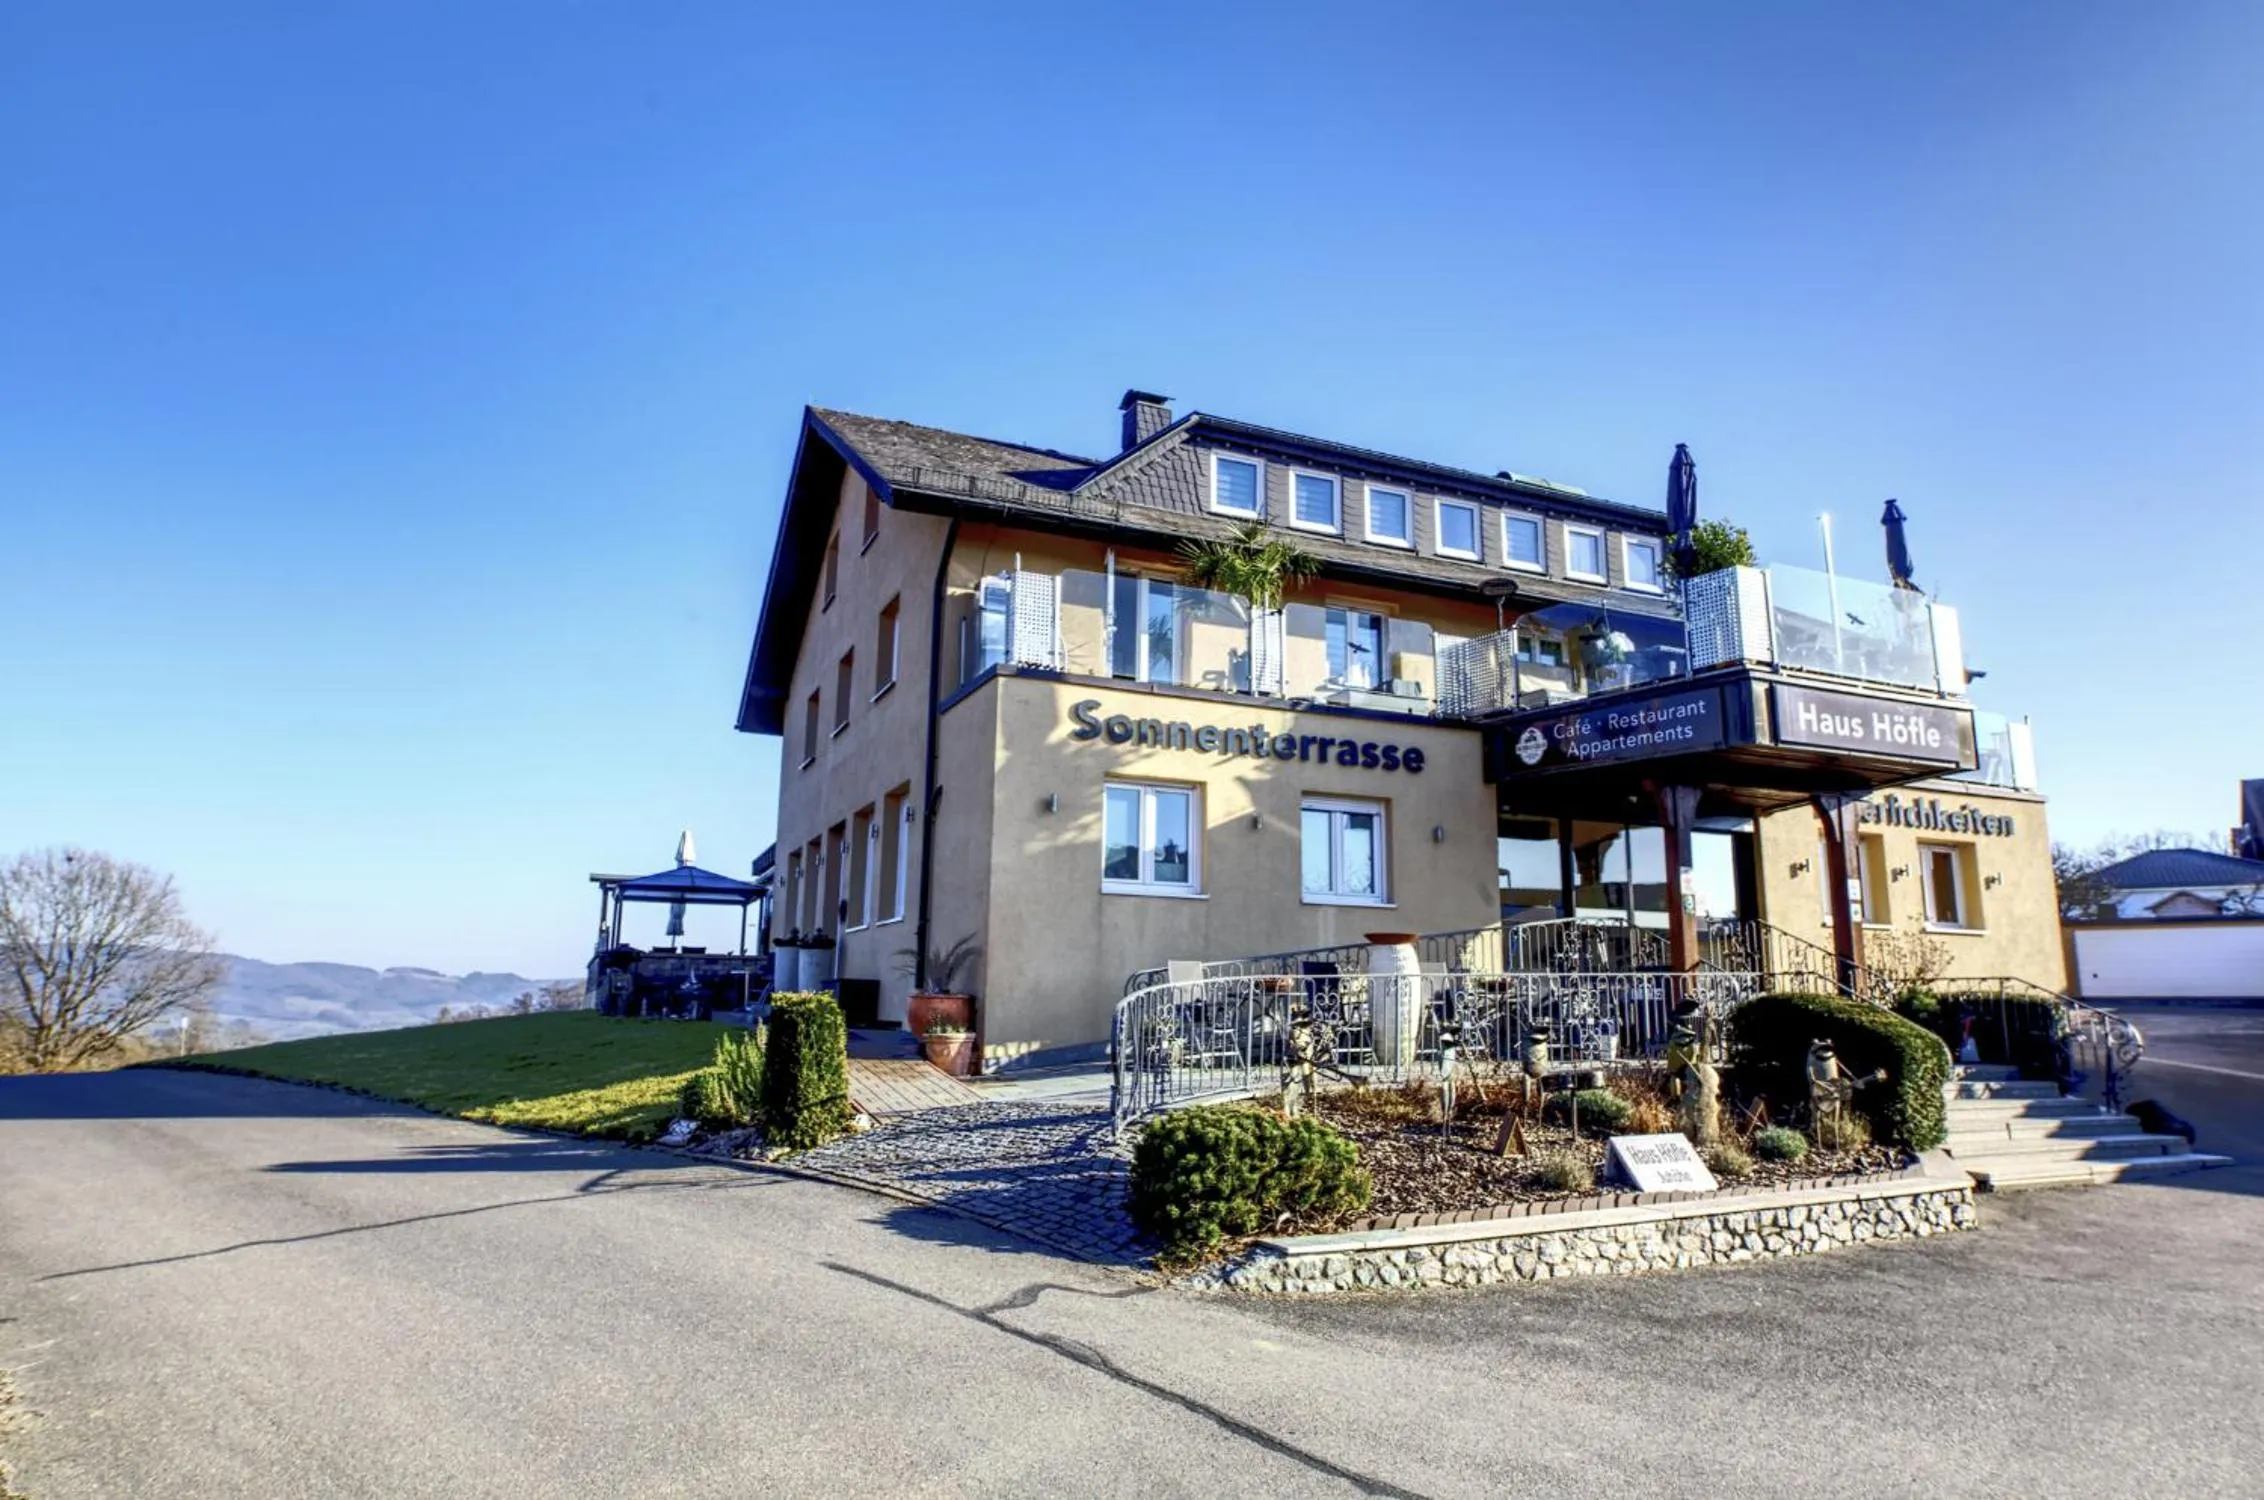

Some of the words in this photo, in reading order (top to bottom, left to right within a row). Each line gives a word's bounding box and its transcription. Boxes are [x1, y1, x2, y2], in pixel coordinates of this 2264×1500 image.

[1068, 699, 1425, 774] Sonnenterrasse
[1553, 719, 1592, 740] Café
[1608, 699, 1706, 730] Restaurant
[1797, 702, 1864, 738] Haus
[1872, 711, 1941, 748] Höfle
[1567, 725, 1694, 761] Appartements
[1861, 793, 2015, 837] erlichkeiten
